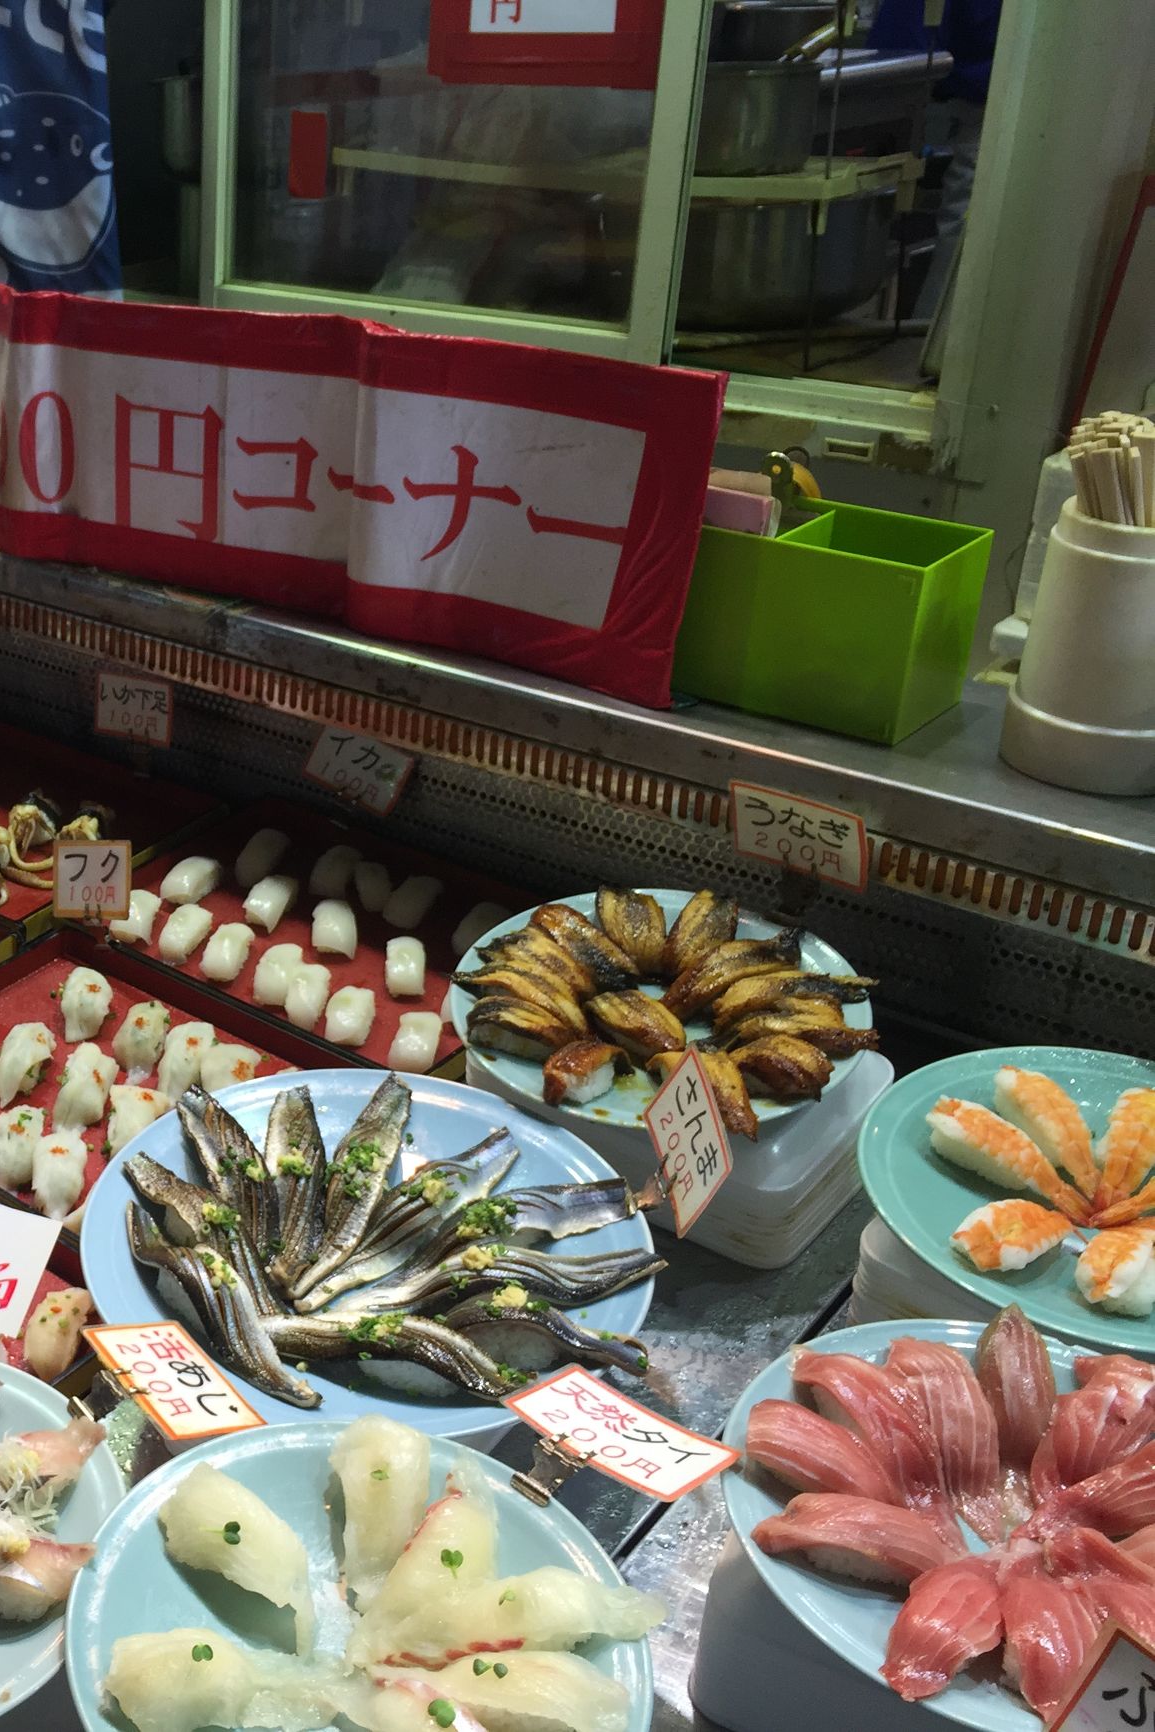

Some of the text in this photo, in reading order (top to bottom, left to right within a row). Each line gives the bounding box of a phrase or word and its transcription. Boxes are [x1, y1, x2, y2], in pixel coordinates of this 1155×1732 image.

[100, 682, 170, 715] いか下足
[329, 736, 381, 771] イカ
[754, 831, 842, 873] 200円
[68, 885, 116, 904] 100円
[659, 1111, 695, 1201] 200円
[674, 1075, 718, 1187] さんま
[115, 1343, 193, 1417] 200円
[139, 1330, 240, 1417] 活あじ
[541, 1408, 663, 1480] 200円
[549, 1380, 711, 1464] 天然タイ
